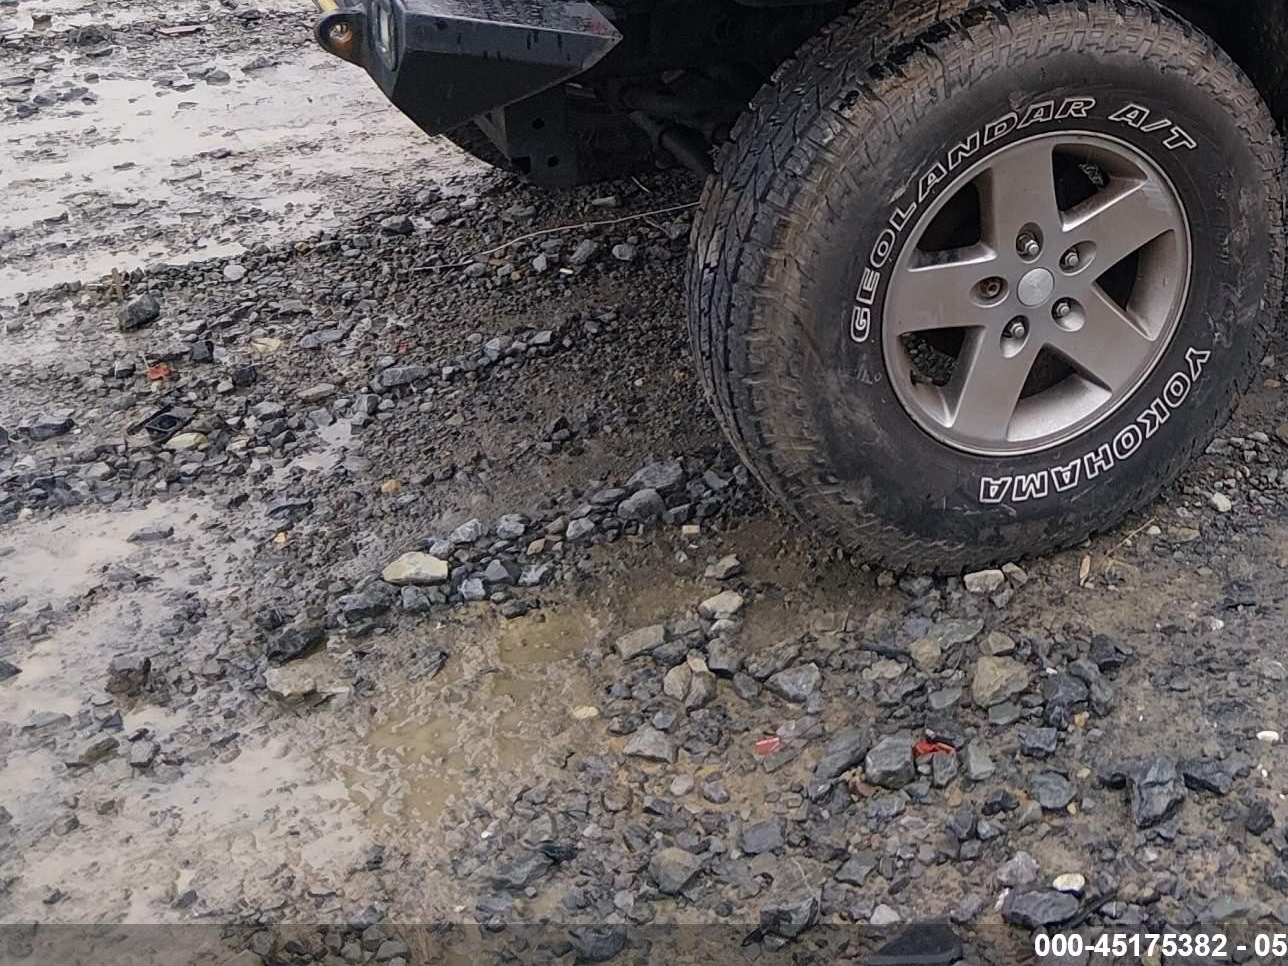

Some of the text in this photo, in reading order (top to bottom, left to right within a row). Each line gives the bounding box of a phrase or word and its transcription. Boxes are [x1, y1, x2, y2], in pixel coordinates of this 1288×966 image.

[850, 96, 1197, 343] GEOLANDAR A/T
[979, 346, 1212, 503] YOKOHAMA
